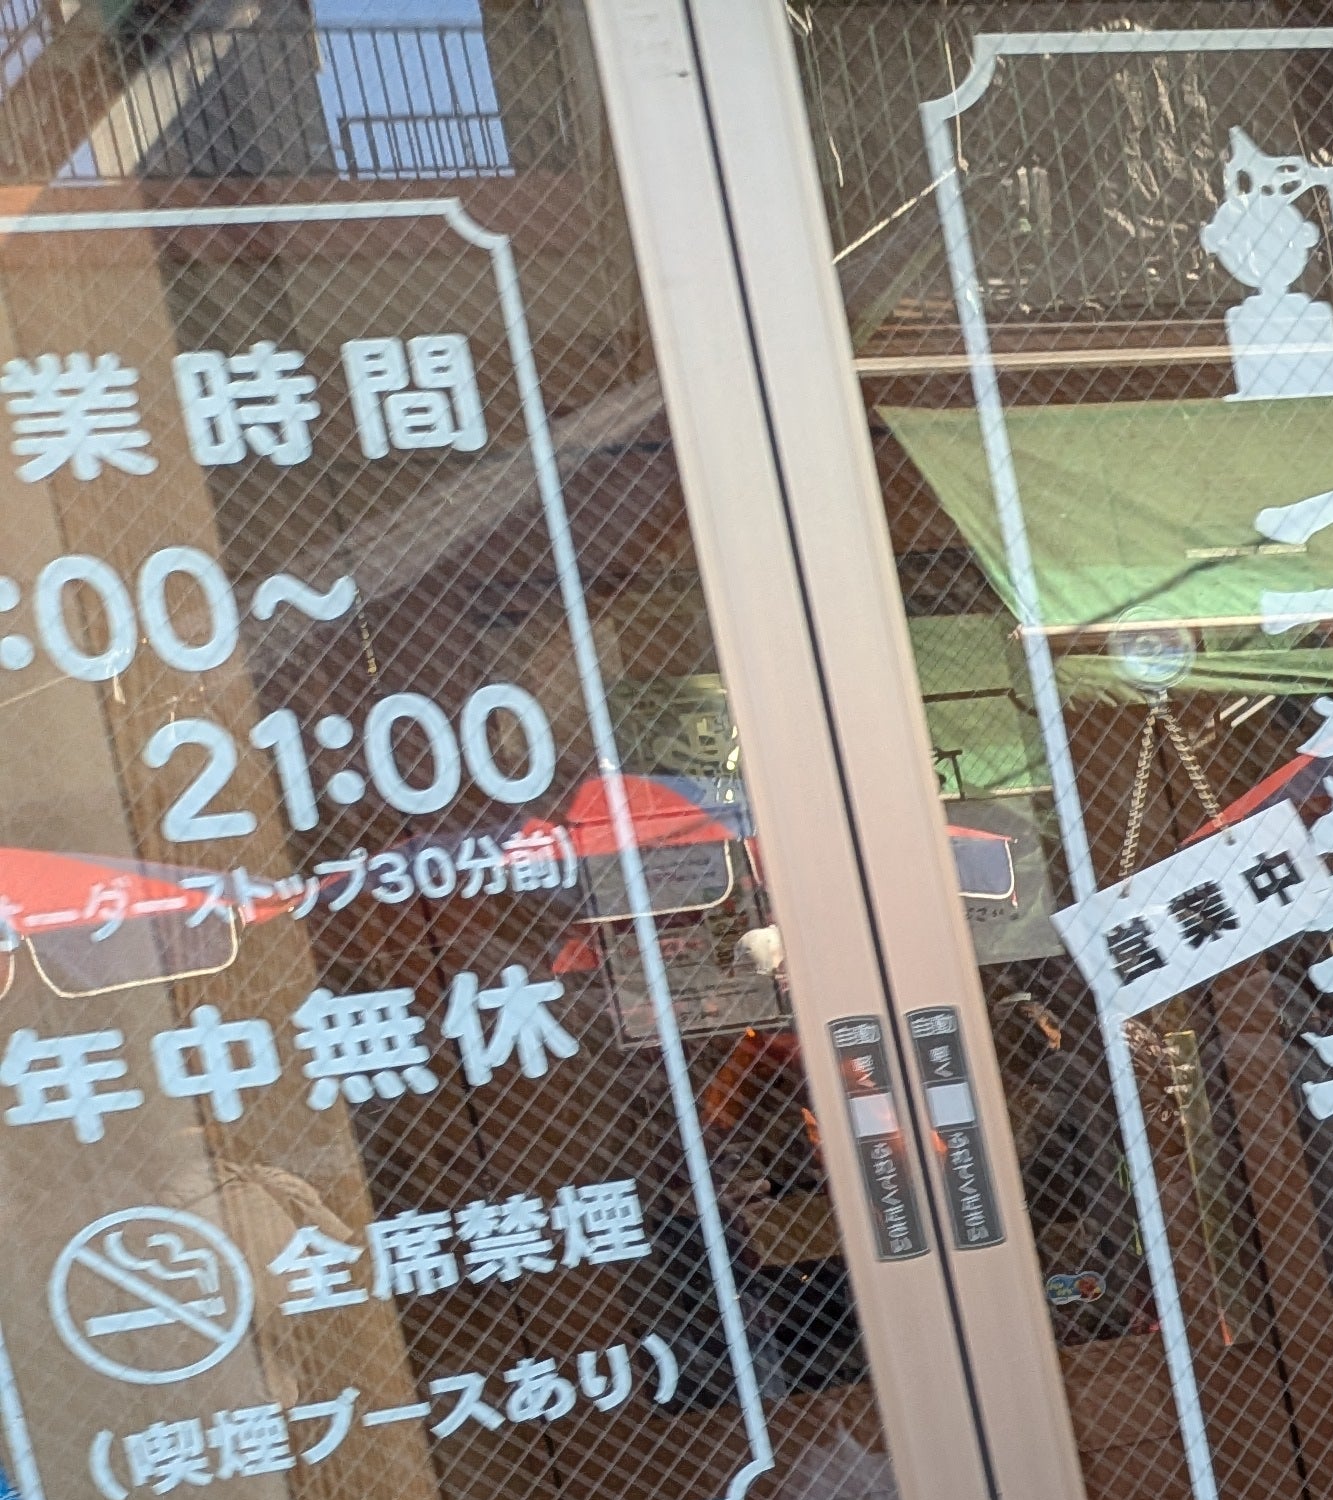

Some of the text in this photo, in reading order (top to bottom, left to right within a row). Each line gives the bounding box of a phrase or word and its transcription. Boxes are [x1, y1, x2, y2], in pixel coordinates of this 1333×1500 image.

[142, 684, 557, 843] 21:00
[1103, 848, 1305, 986] 営業中
[2, 963, 579, 1144] 年中無休
[269, 1179, 653, 1317] 全席禁煙
